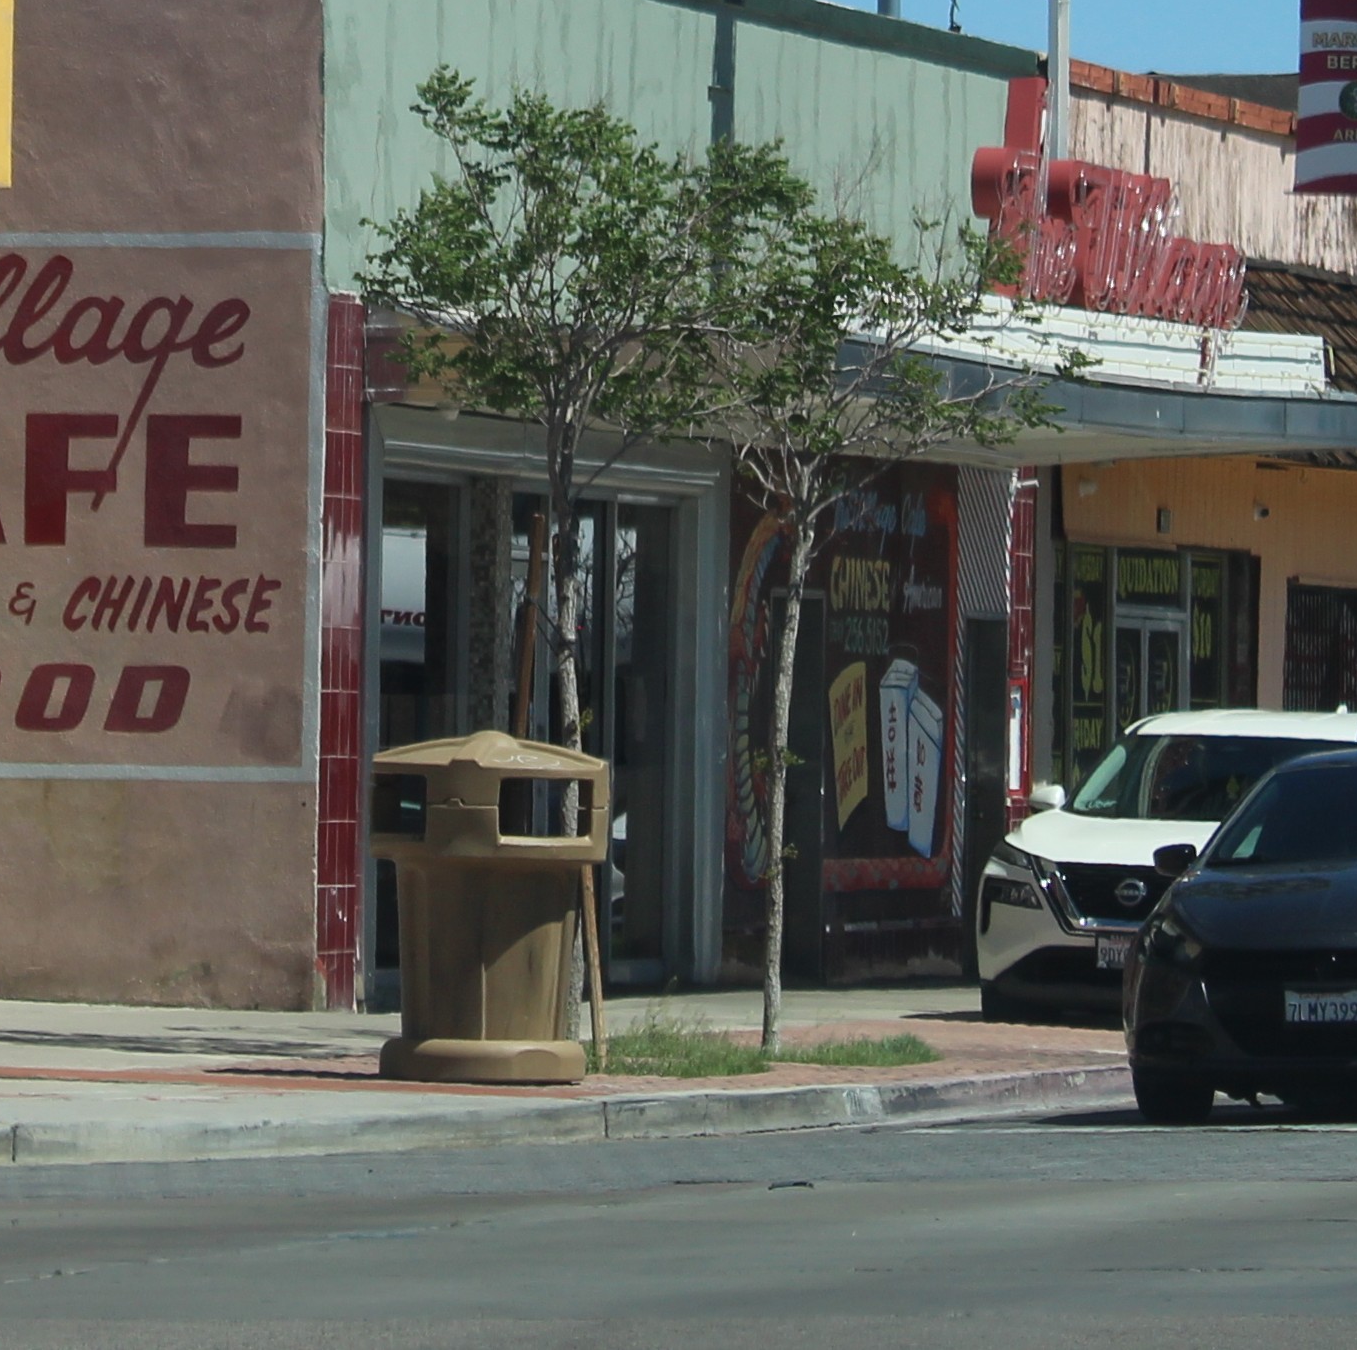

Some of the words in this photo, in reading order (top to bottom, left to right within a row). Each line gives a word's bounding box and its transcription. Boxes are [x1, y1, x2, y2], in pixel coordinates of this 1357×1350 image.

[8, 582, 36, 625] &
[63, 574, 281, 635] CHINESE
[830, 556, 890, 612] CHINESE
